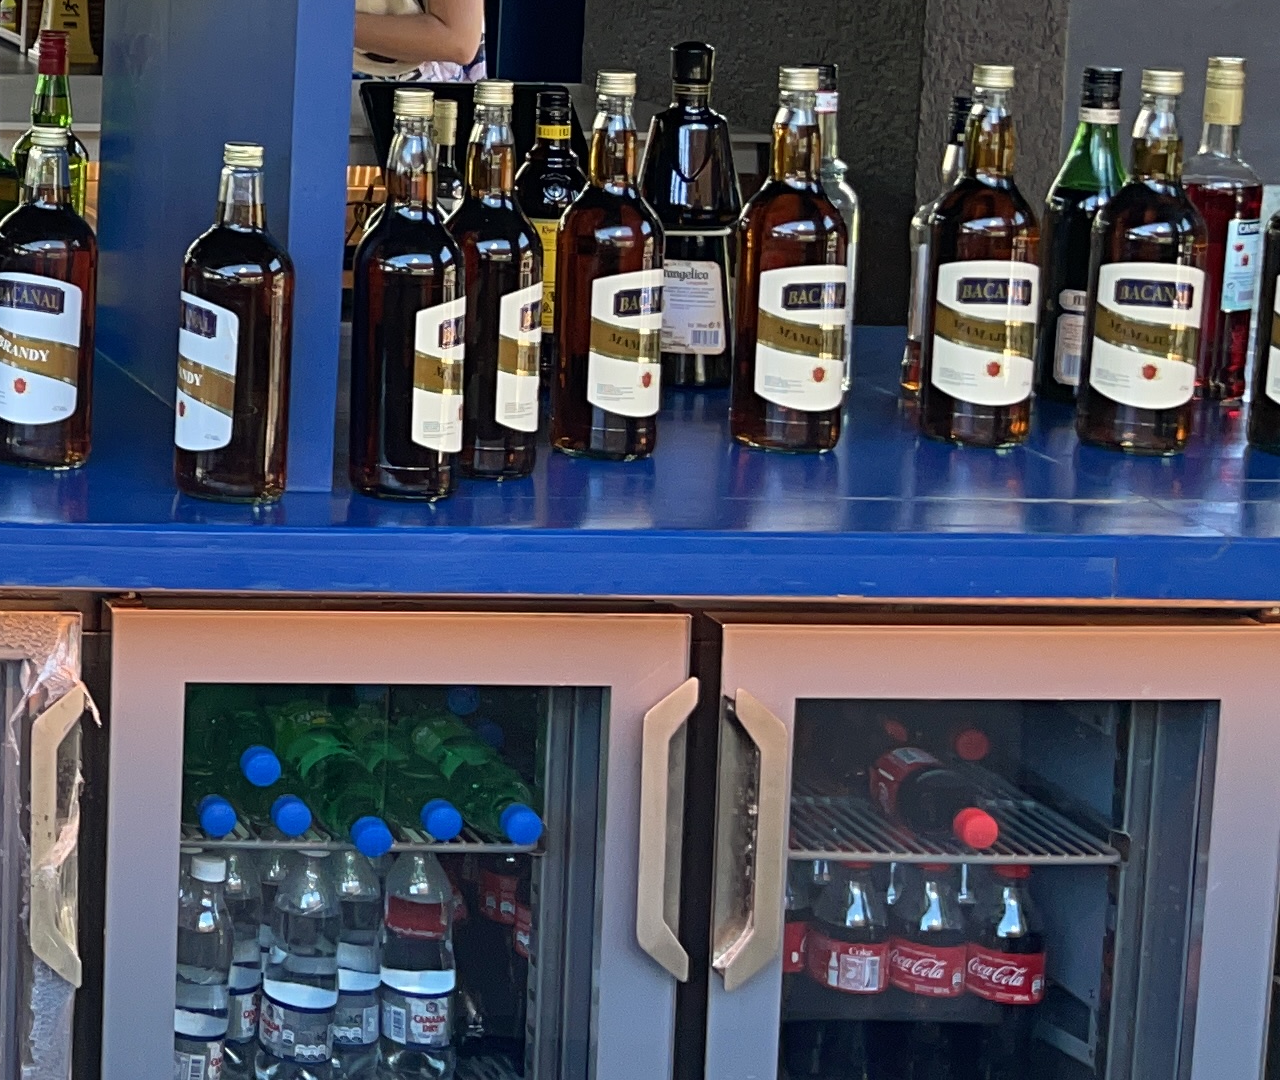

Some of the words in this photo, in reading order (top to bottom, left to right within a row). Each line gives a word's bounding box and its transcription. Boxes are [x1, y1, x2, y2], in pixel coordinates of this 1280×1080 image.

[848, 946, 873, 956] Coke
[890, 949, 946, 979] Coca-Cola
[968, 956, 1029, 986] Coca-Cola
[413, 1014, 446, 1023] CANADA
[422, 1023, 439, 1032] DRY
